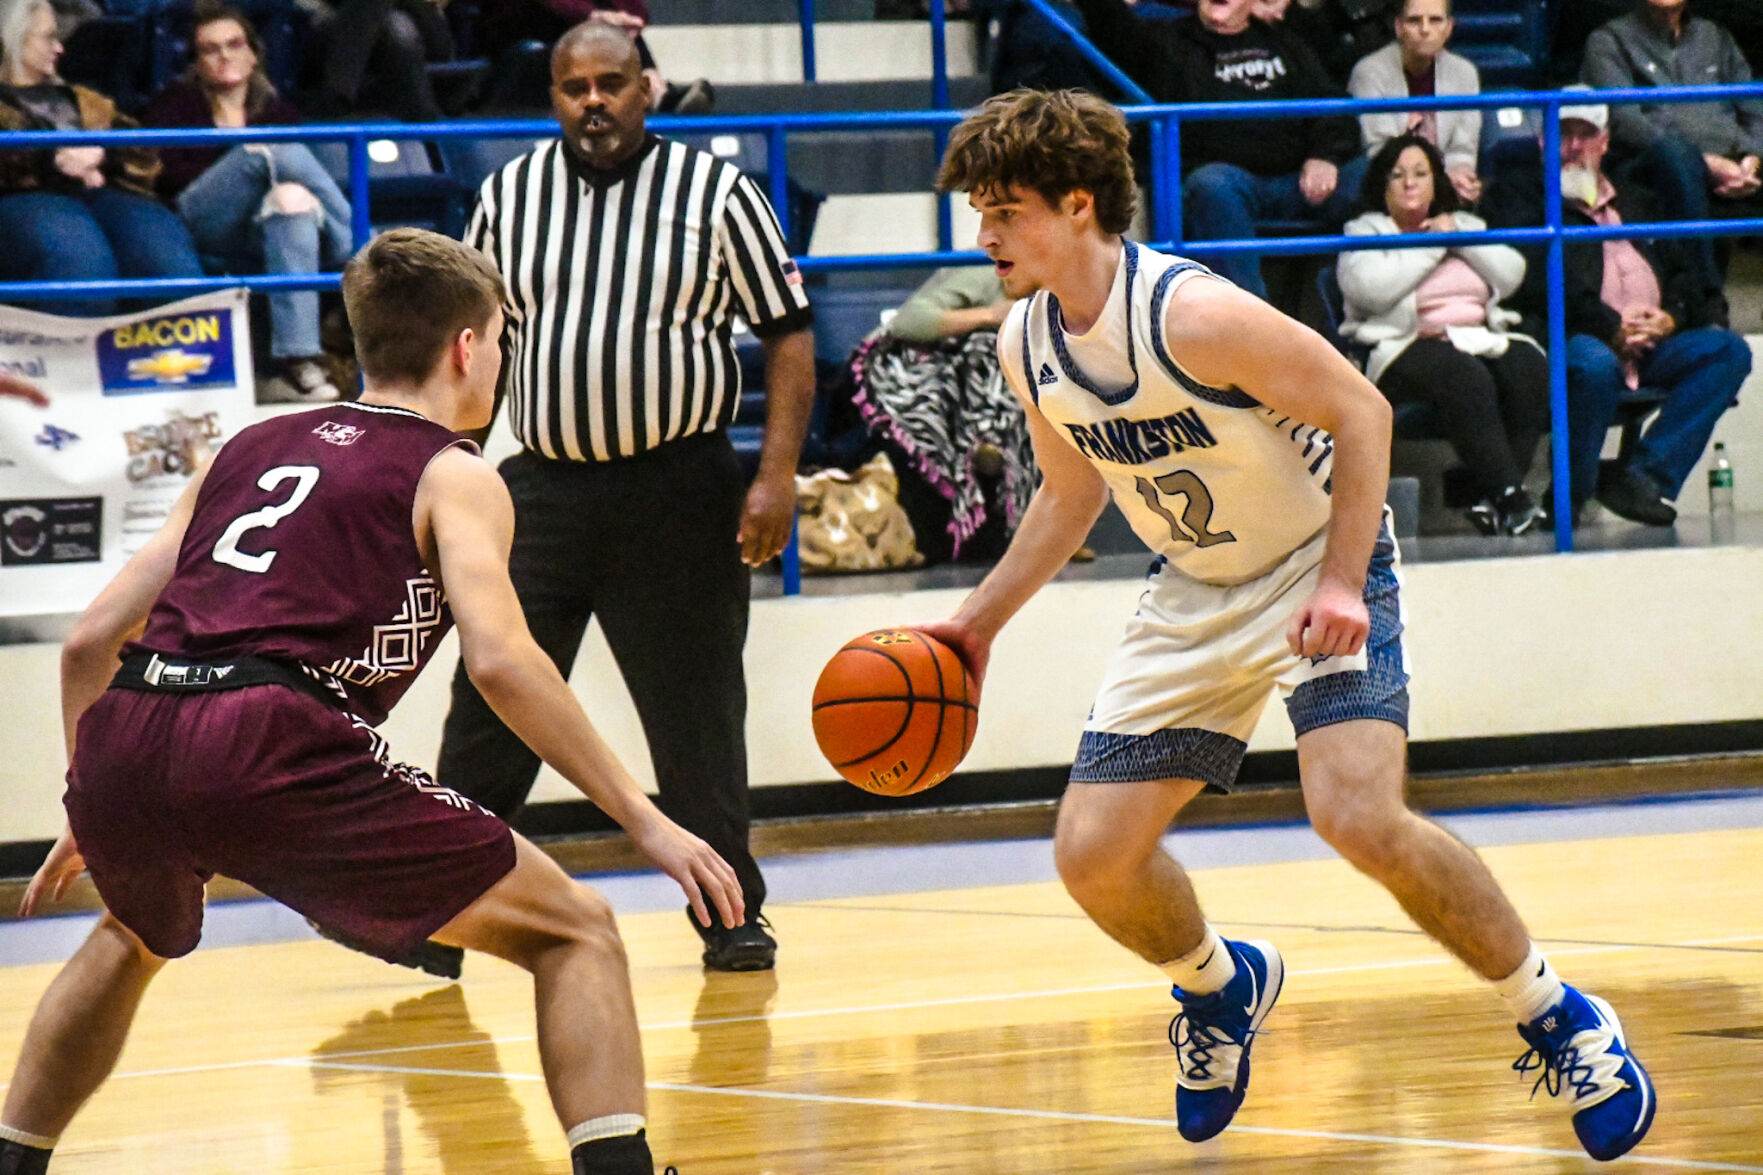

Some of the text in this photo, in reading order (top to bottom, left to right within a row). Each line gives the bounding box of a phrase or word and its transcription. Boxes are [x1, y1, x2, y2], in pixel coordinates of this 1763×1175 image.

[113, 315, 219, 349] BACON
[1062, 406, 1218, 465] FRANKSTON
[212, 465, 320, 573] 2
[1134, 469, 1238, 549] 12
